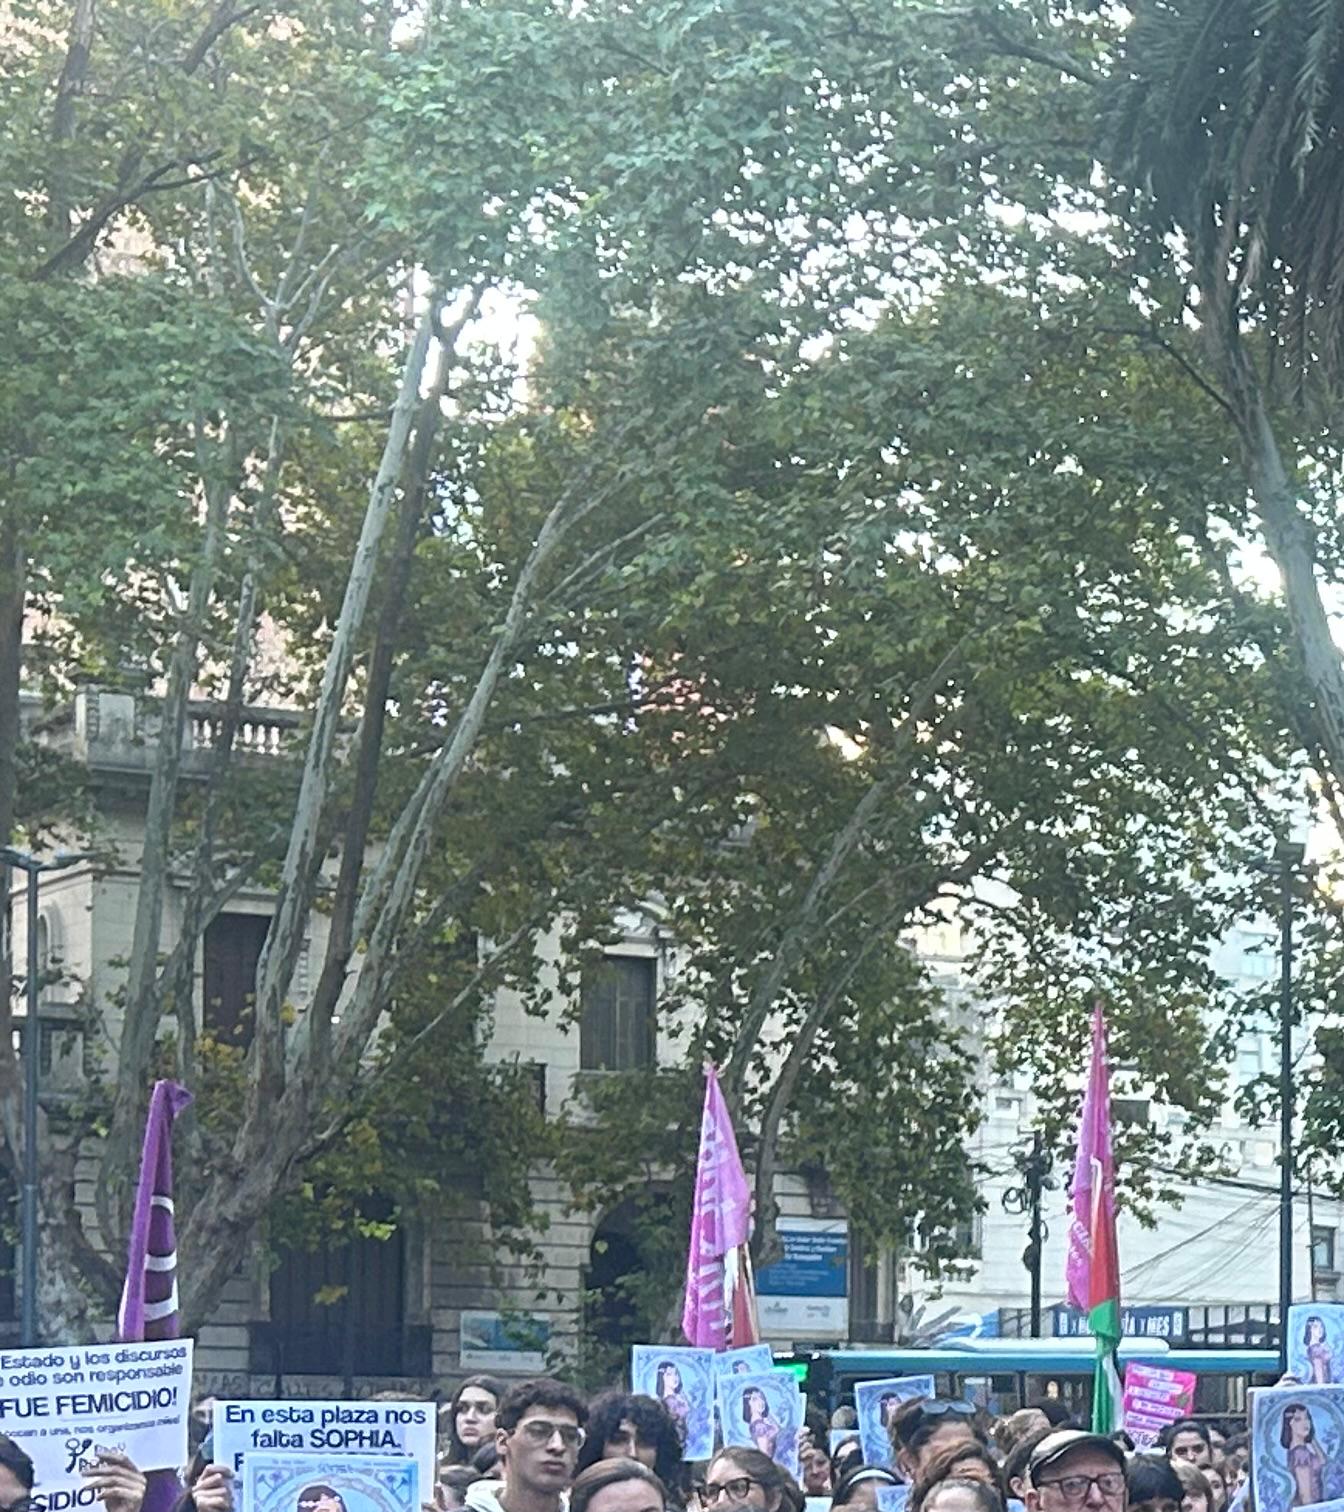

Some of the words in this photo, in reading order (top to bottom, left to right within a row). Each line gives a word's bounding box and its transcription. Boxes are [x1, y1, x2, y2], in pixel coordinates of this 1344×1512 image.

[70, 1355, 80, 1370] y
[85, 1351, 110, 1365] los
[115, 1346, 187, 1363] discursos
[9, 1371, 48, 1387] odio
[53, 1372, 84, 1385] son
[56, 1386, 178, 1416] FEMICIDIO!
[225, 1405, 255, 1424] En
[261, 1407, 314, 1424] esta
[321, 1405, 379, 1429] plaza
[385, 1409, 427, 1424] nos
[251, 1429, 304, 1449] falta
[310, 1429, 402, 1449] SOPHIA.
